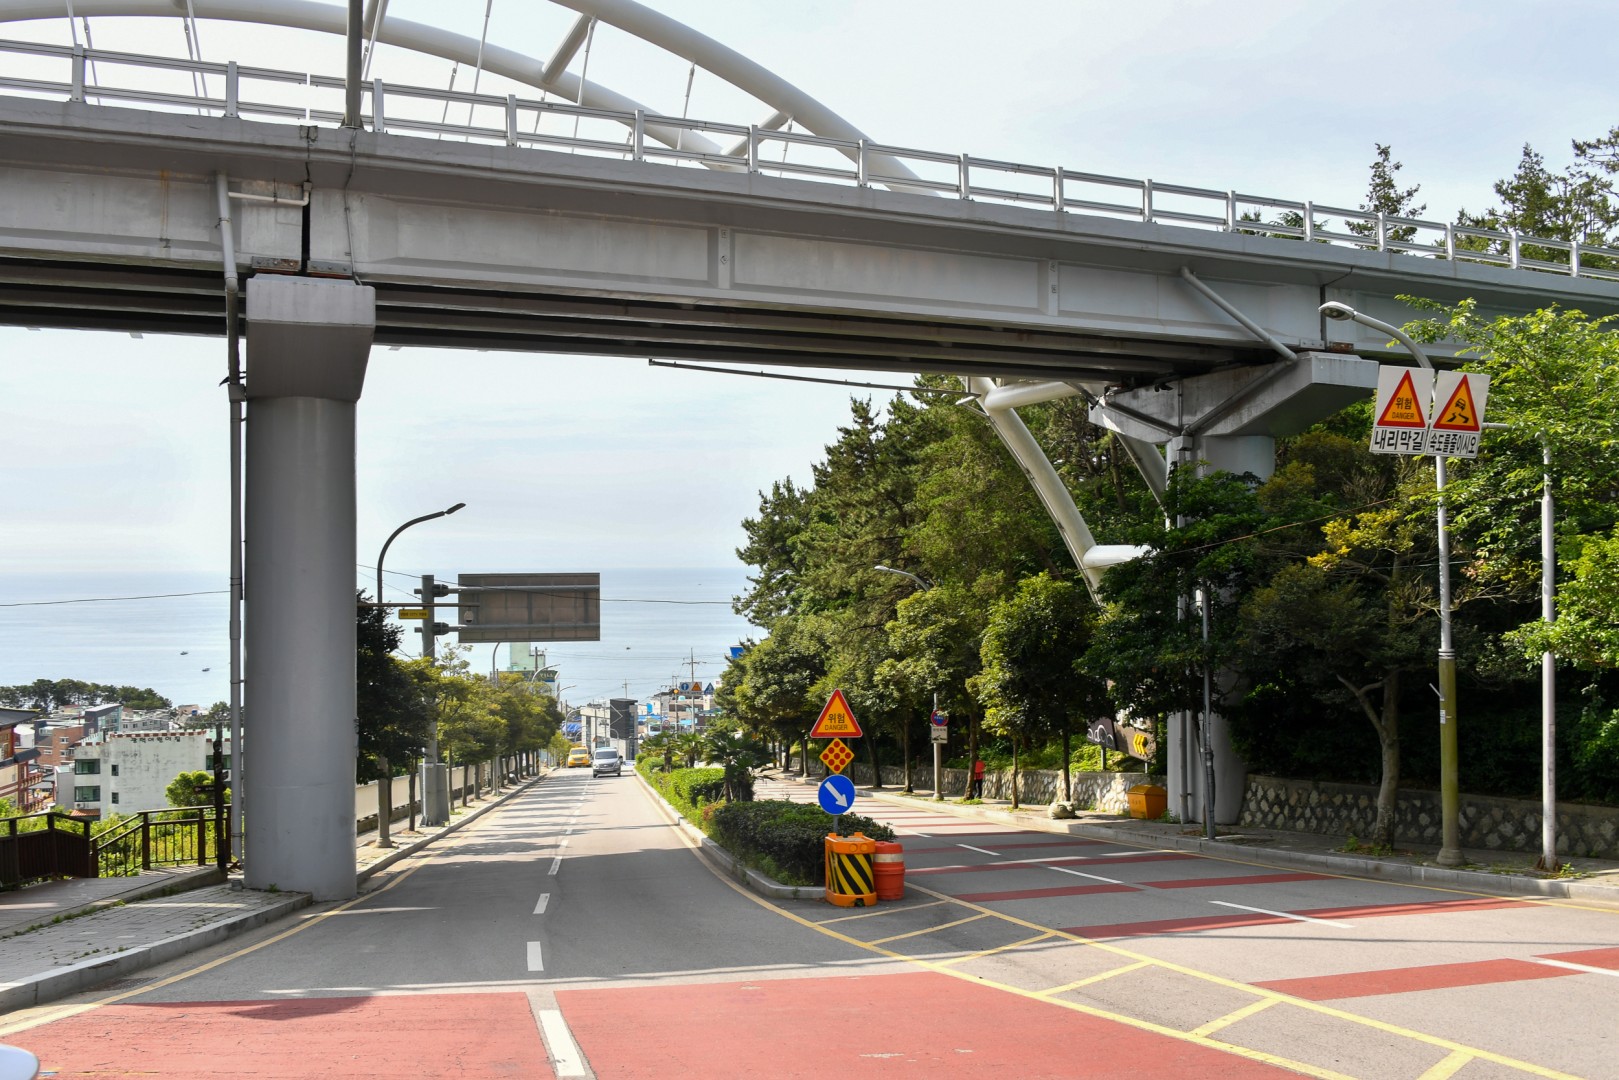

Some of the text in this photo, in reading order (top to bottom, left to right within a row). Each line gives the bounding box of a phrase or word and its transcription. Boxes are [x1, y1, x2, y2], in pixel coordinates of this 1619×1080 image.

[1396, 397, 1412, 410] 위험
[1391, 411, 1415, 420] DANGER
[1374, 429, 1424, 451] 내리막길
[828, 713, 845, 724] 위험
